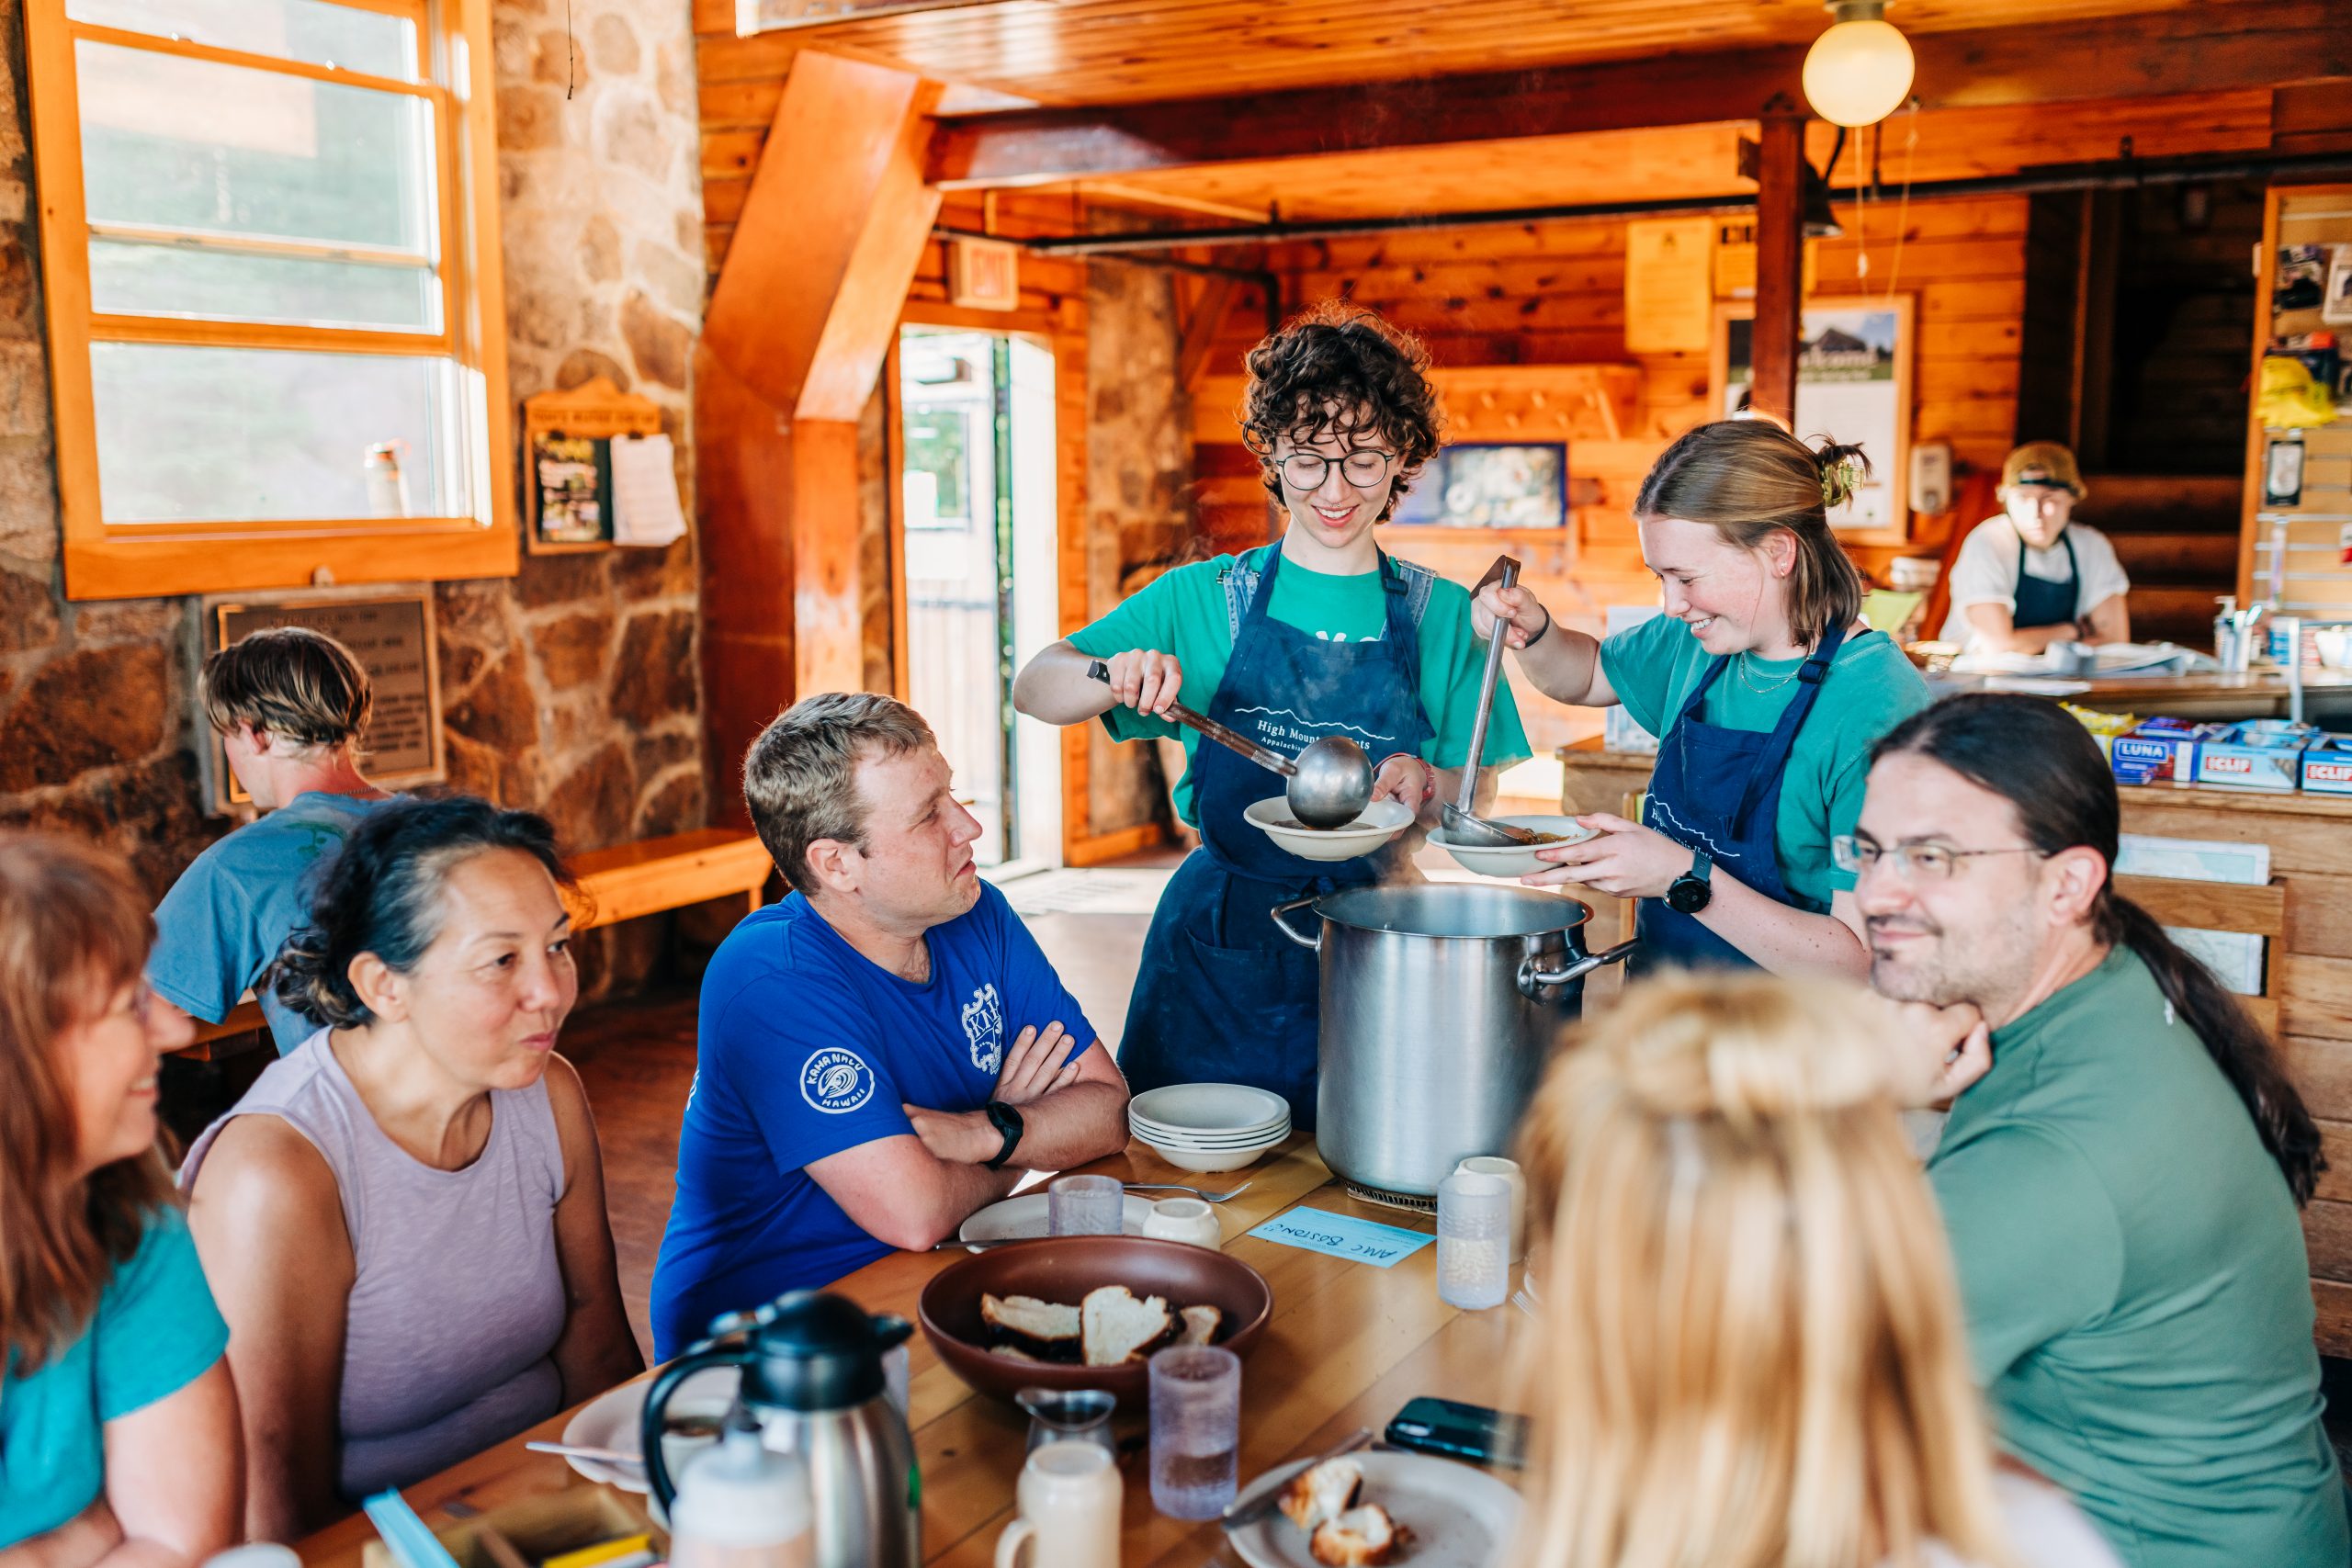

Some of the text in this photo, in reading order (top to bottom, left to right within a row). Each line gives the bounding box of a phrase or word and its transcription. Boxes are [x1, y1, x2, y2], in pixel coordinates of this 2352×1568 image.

[1257, 720, 1285, 737] High
[1289, 728, 1320, 744] Mount
[2120, 742, 2164, 759] LUNA
[2216, 758, 2250, 773] CLIF
[821, 1088, 865, 1108] HAWAII
[1282, 1227, 1344, 1247] BOSTON
[1351, 1244, 1398, 1259] AMC
